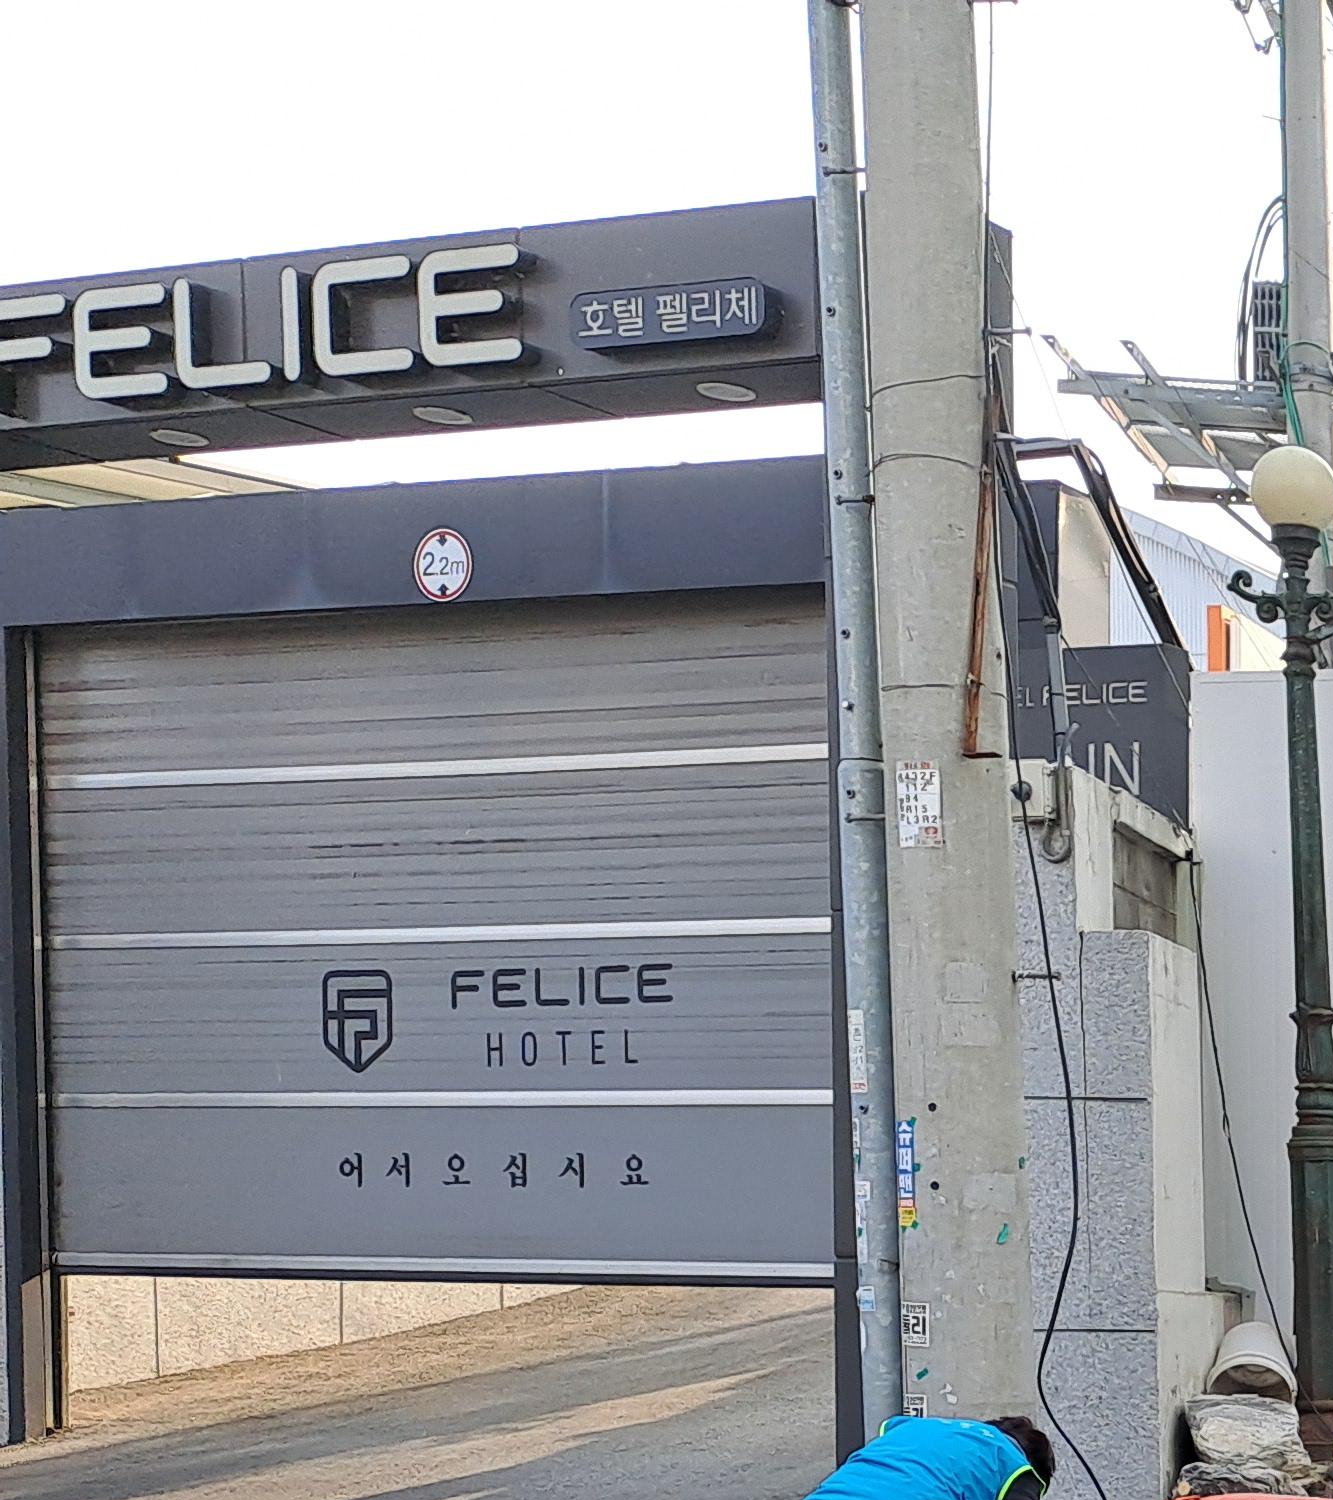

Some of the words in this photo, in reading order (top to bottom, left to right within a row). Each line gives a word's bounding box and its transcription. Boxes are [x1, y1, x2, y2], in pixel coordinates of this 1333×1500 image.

[577, 295, 644, 338] 호텔
[655, 285, 758, 334] 펠리체
[1087, 741, 1141, 797] IN
[451, 963, 674, 1010] FELICE
[486, 1029, 639, 1068] HOTEL
